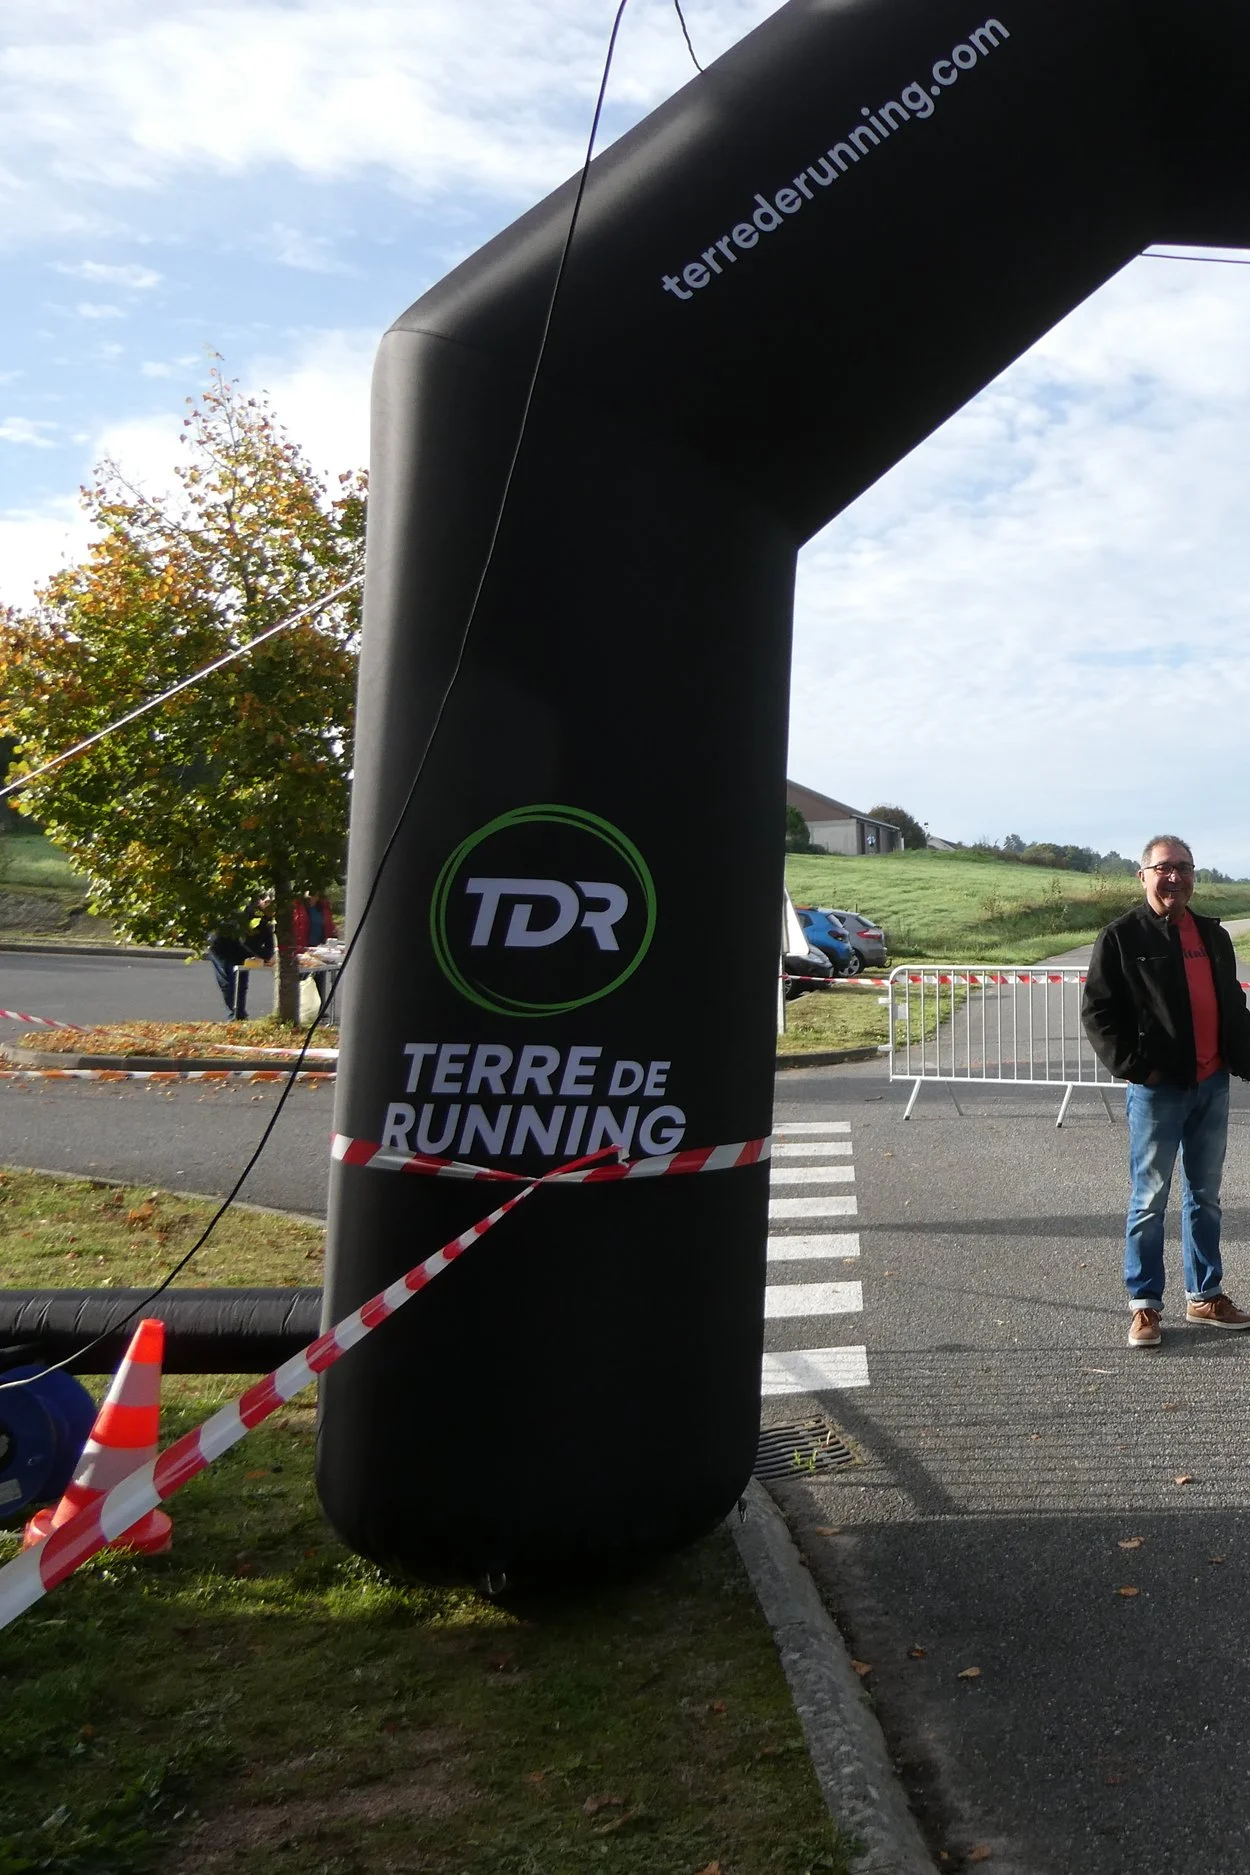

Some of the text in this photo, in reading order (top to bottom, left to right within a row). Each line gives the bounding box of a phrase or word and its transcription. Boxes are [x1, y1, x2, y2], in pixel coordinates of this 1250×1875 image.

[661, 15, 1011, 300] terrederunning.com
[465, 877, 629, 951] TDR
[404, 1042, 672, 1097] TERRE DE
[381, 1102, 687, 1156] RUNNING
